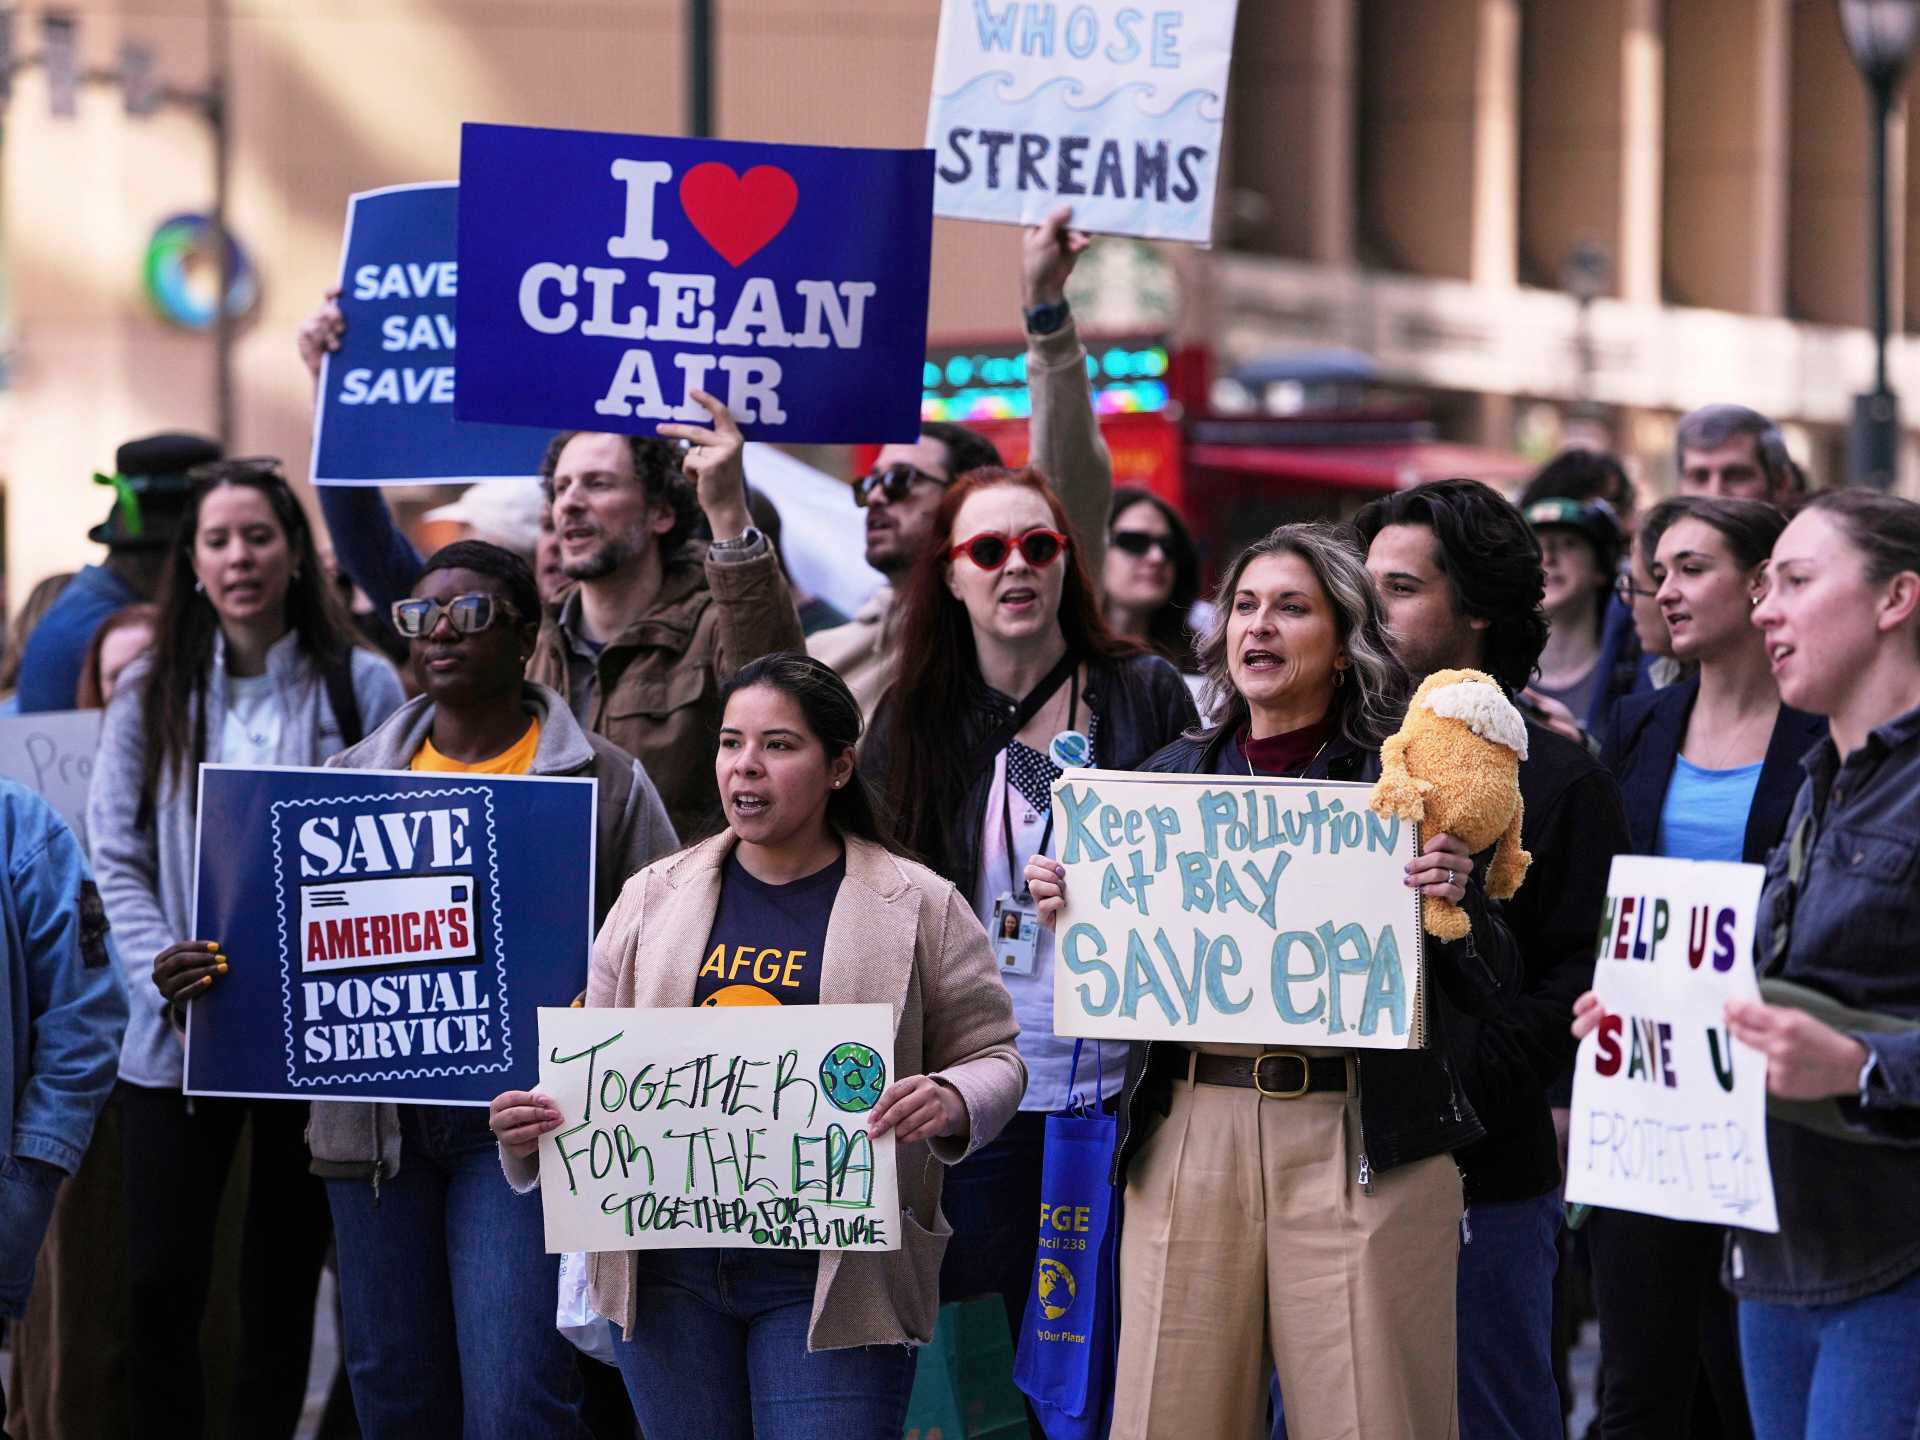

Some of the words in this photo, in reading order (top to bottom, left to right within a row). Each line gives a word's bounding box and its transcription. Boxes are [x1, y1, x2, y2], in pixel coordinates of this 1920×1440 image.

[974, 0, 1183, 68] WHOSE
[938, 128, 1207, 202] STREAMS
[607, 158, 672, 261] I
[354, 262, 458, 301] SAVE
[519, 262, 876, 349] CLEAN
[382, 314, 456, 352] SAV
[339, 367, 455, 404] SAVE
[594, 349, 787, 425] AIR
[25, 732, 94, 791] Pro
[299, 808, 472, 877] SAVE
[1176, 850, 1291, 929] BAY
[307, 907, 469, 962] AMERICA'S
[1597, 896, 1670, 963] HELP
[1688, 905, 1736, 973] US
[699, 943, 808, 988] AFGE
[302, 970, 490, 1021] POSTAL
[304, 1015, 492, 1064] SERVICE
[1595, 1014, 1677, 1088] SAVE
[550, 1030, 818, 1128] TOGETHER
[554, 1120, 655, 1196] FOR
[663, 1126, 779, 1196] THE
[791, 1122, 876, 1207] EPA
[600, 1191, 758, 1237] TOGETHER
[756, 1196, 817, 1230] FOR
[797, 1213, 888, 1248] FUTURE
[1039, 1236, 1060, 1249] ncil
[1063, 1238, 1087, 1251] 238
[1040, 1203, 1091, 1232] FGE
